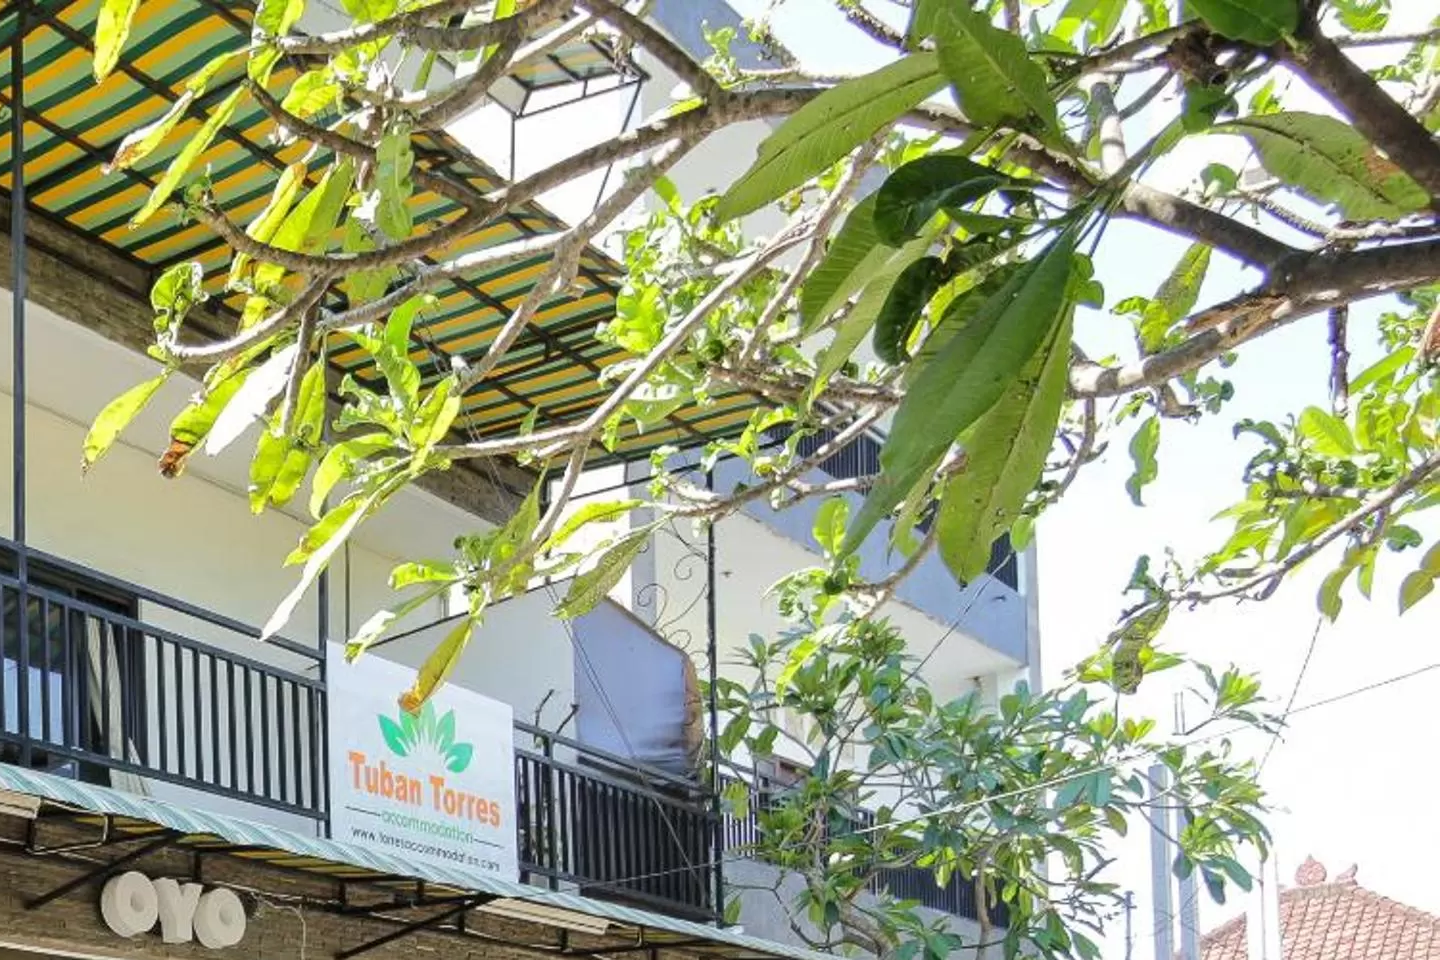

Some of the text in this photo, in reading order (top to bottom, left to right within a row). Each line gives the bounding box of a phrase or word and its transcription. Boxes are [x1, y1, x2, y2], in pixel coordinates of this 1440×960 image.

[348, 751, 502, 829] Tuban Torres
[101, 871, 247, 949] OYO
